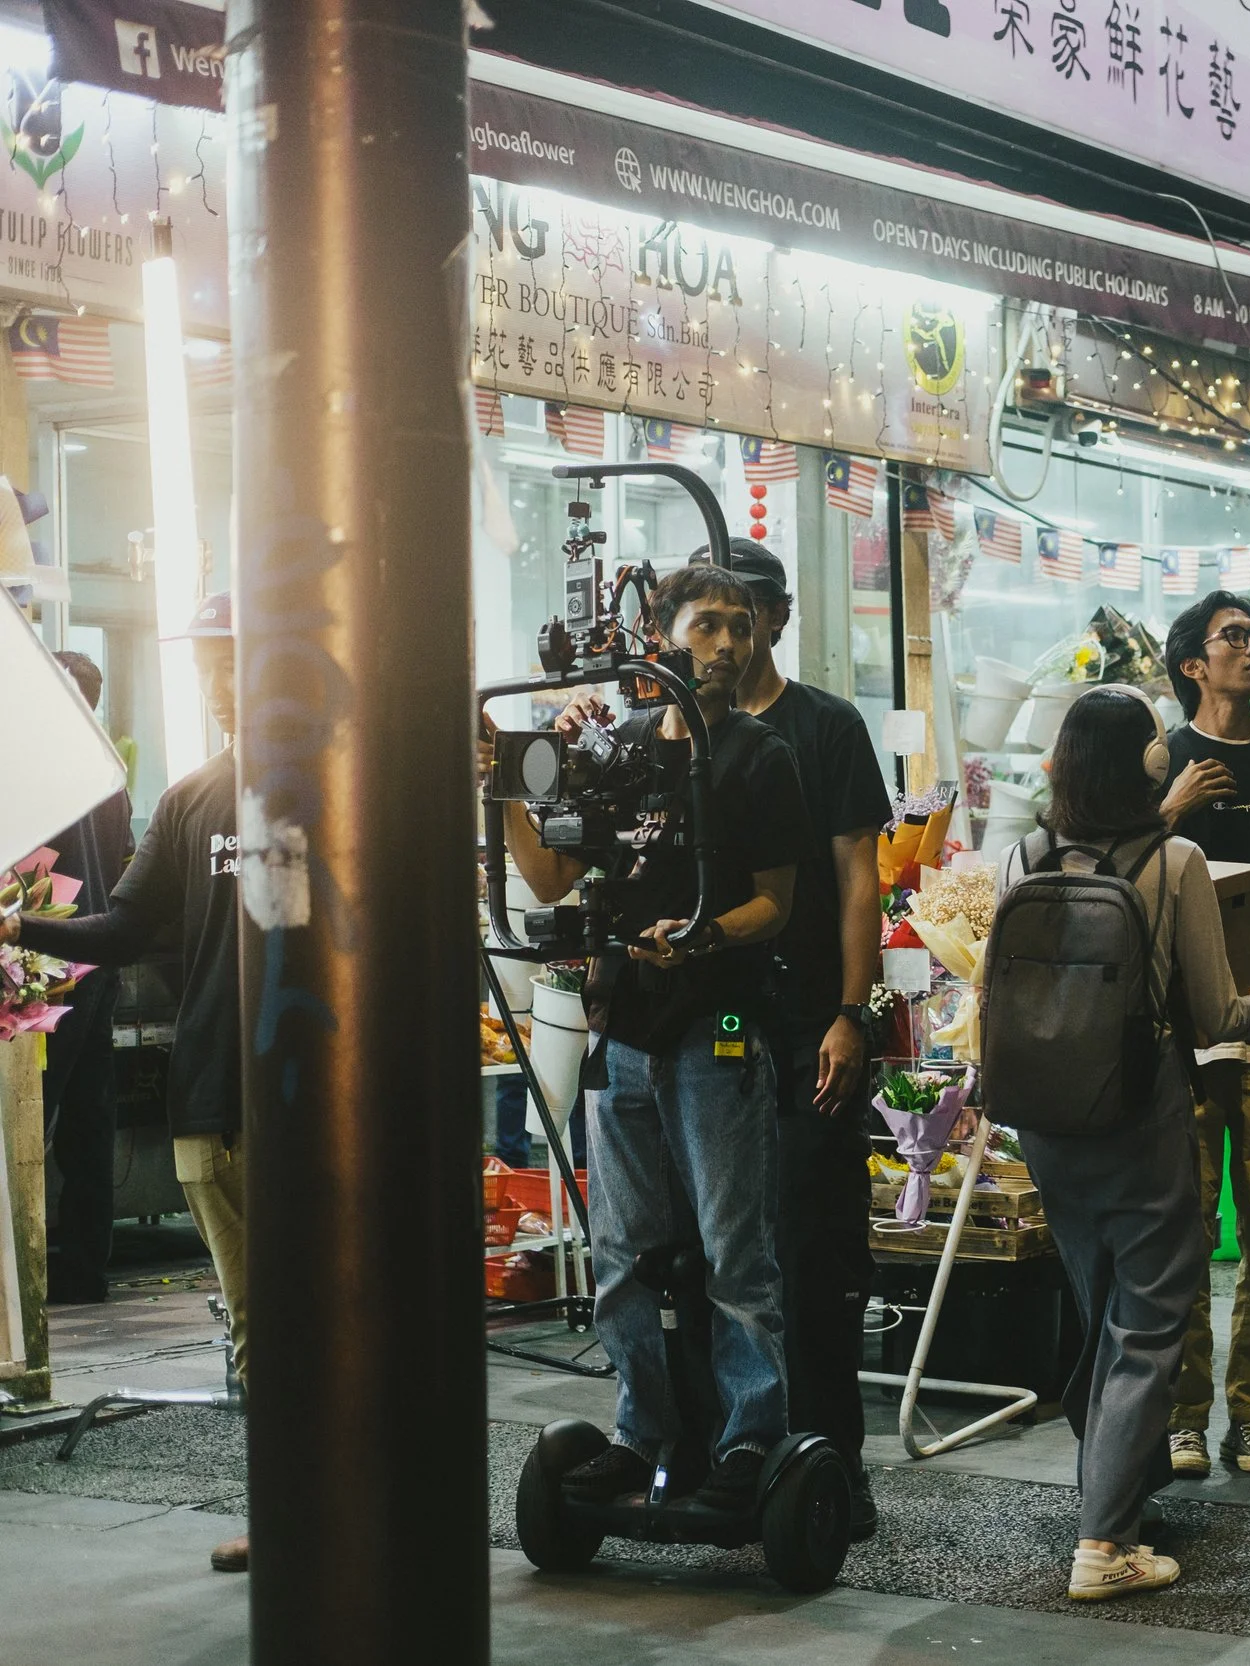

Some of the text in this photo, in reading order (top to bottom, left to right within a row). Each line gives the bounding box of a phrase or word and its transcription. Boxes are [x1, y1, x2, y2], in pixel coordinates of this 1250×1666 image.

[8, 256, 36, 278] SINCE
[57, 221, 134, 266] FLOWERS
[650, 163, 841, 232] WWW.WENGHOA.COM
[873, 218, 918, 249] OPEN
[919, 230, 929, 249] 7
[931, 232, 970, 262] DAYS
[973, 242, 1053, 280] INCLUDING
[1054, 261, 1104, 292] PUBLIC
[1104, 273, 1169, 307] HOLIDAYS
[1193, 294, 1203, 314] 8
[1203, 296, 1226, 319] AM
[474, 273, 512, 310] ER
[517, 282, 641, 339] BOUTIQUE
